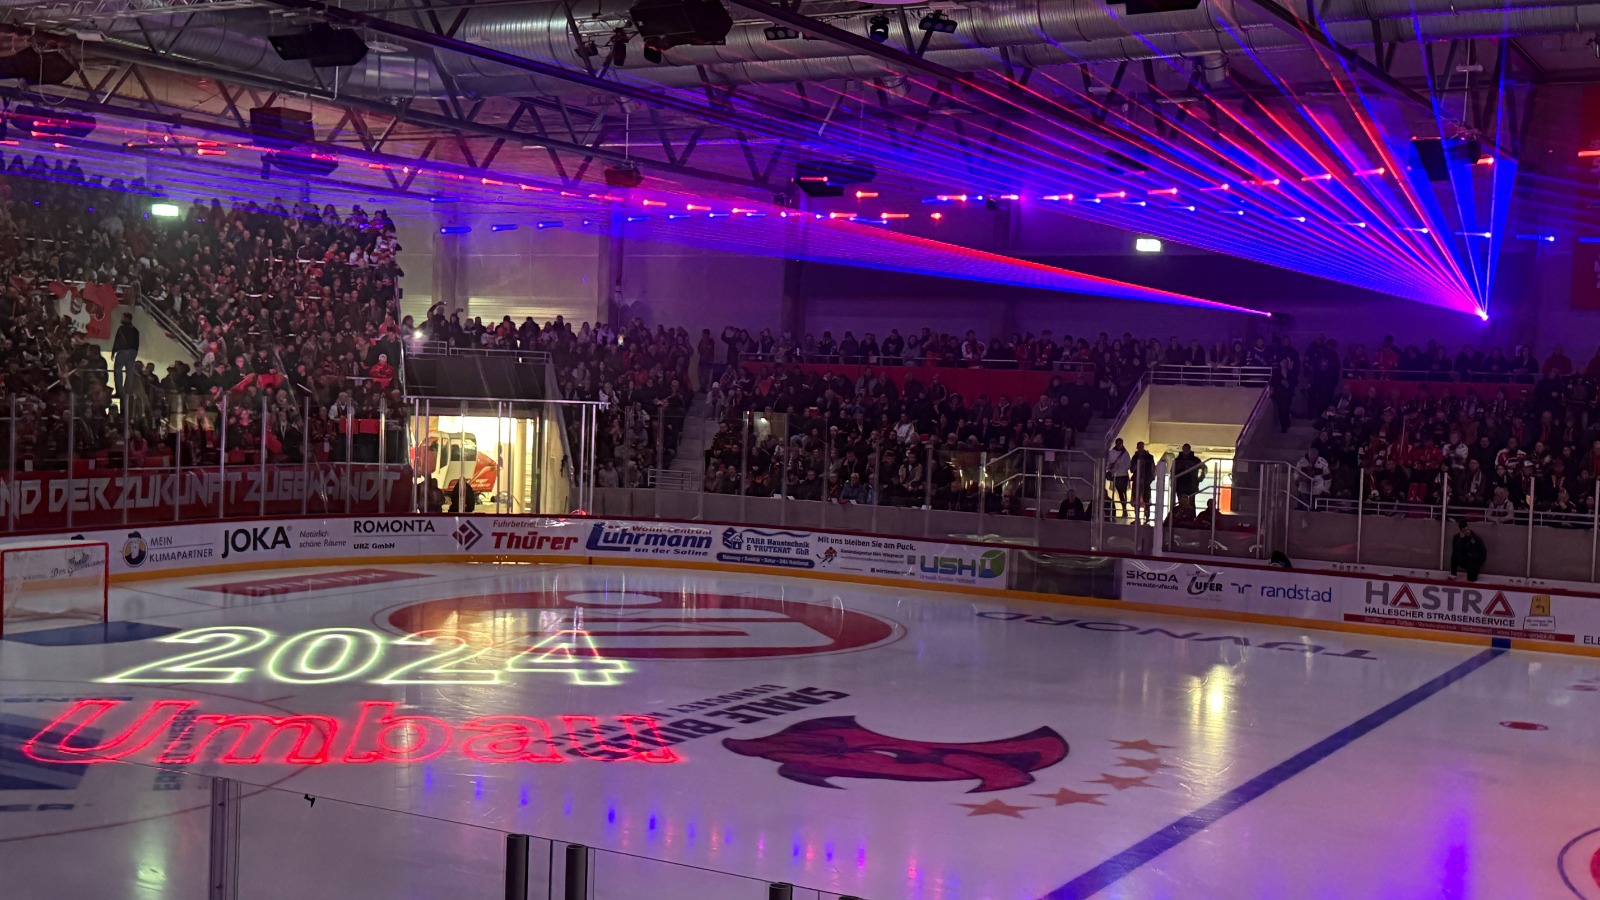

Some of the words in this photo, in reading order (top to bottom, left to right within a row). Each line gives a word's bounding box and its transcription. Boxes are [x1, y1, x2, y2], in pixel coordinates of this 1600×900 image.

[49, 477, 112, 513] DER
[113, 471, 242, 510] ZUKUNFT
[243, 469, 401, 504] ZUGEWANDT
[353, 519, 436, 534] ROMONTA
[150, 536, 173, 547] MEIN
[221, 526, 292, 559] JOKA
[371, 542, 395, 550] GmbH
[491, 531, 579, 551] Thürer
[830, 537, 843, 545] uns
[844, 538, 870, 547] bleiben
[871, 540, 882, 548] Sie
[150, 549, 214, 563] KLIMAPARTNER
[673, 548, 709, 556] Saline
[920, 554, 976, 577] USH
[1195, 581, 1223, 592] UFER
[1260, 584, 1332, 603] randstad
[1365, 580, 1516, 617] HASTRA
[1364, 606, 1424, 619] HALLESCHER
[1426, 612, 1516, 628] STRASSENSERVICE
[96, 626, 636, 686] 2024
[667, 683, 788, 714] EISHOCKEY
[704, 686, 851, 726] SAALE
[21, 699, 682, 765] Umbau
